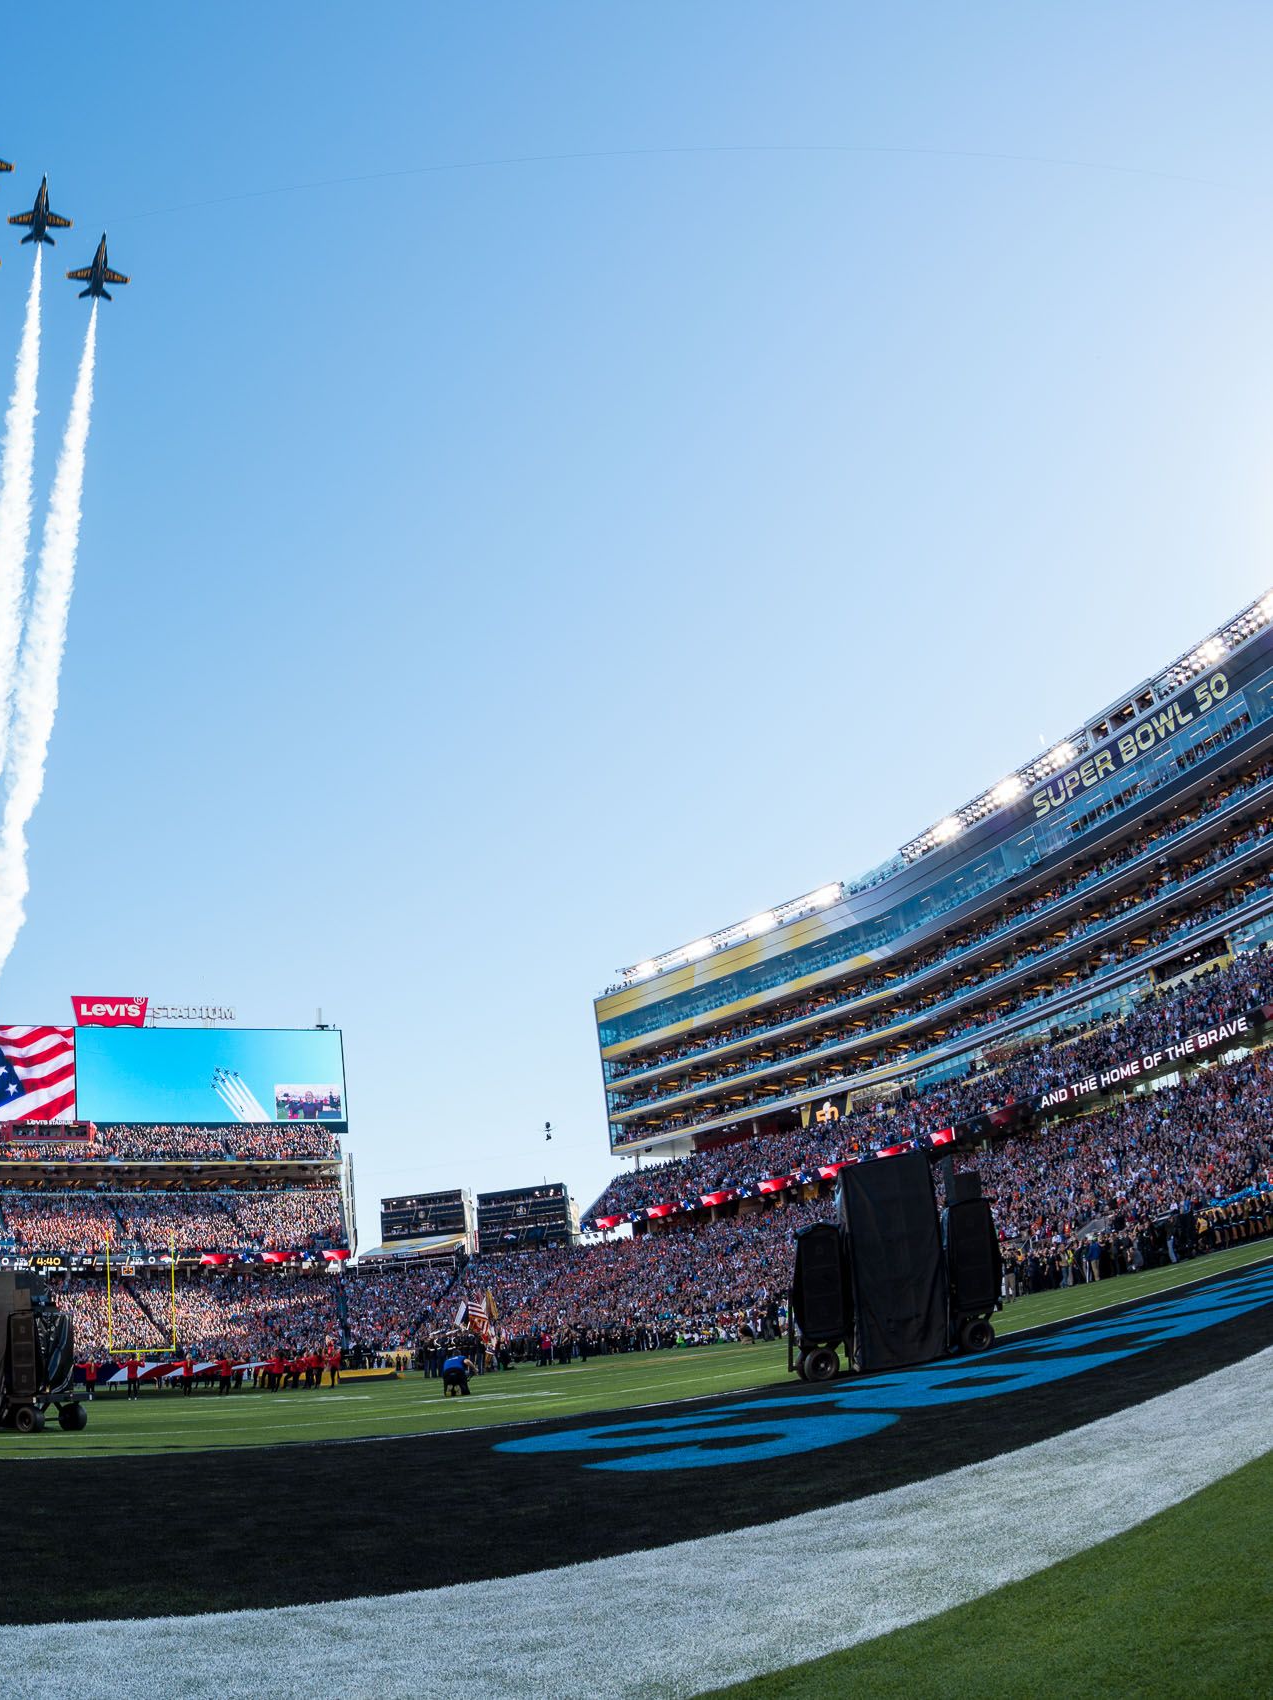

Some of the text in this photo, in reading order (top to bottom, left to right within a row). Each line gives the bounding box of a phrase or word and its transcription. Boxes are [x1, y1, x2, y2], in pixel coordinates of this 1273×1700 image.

[1032, 672, 1229, 818] SUPER BOWL 50
[153, 1004, 236, 1020] STADIUM
[1041, 1017, 1249, 1109] AND THE HOME OF THE BRAVE
[36, 1257, 61, 1266] 4:40
